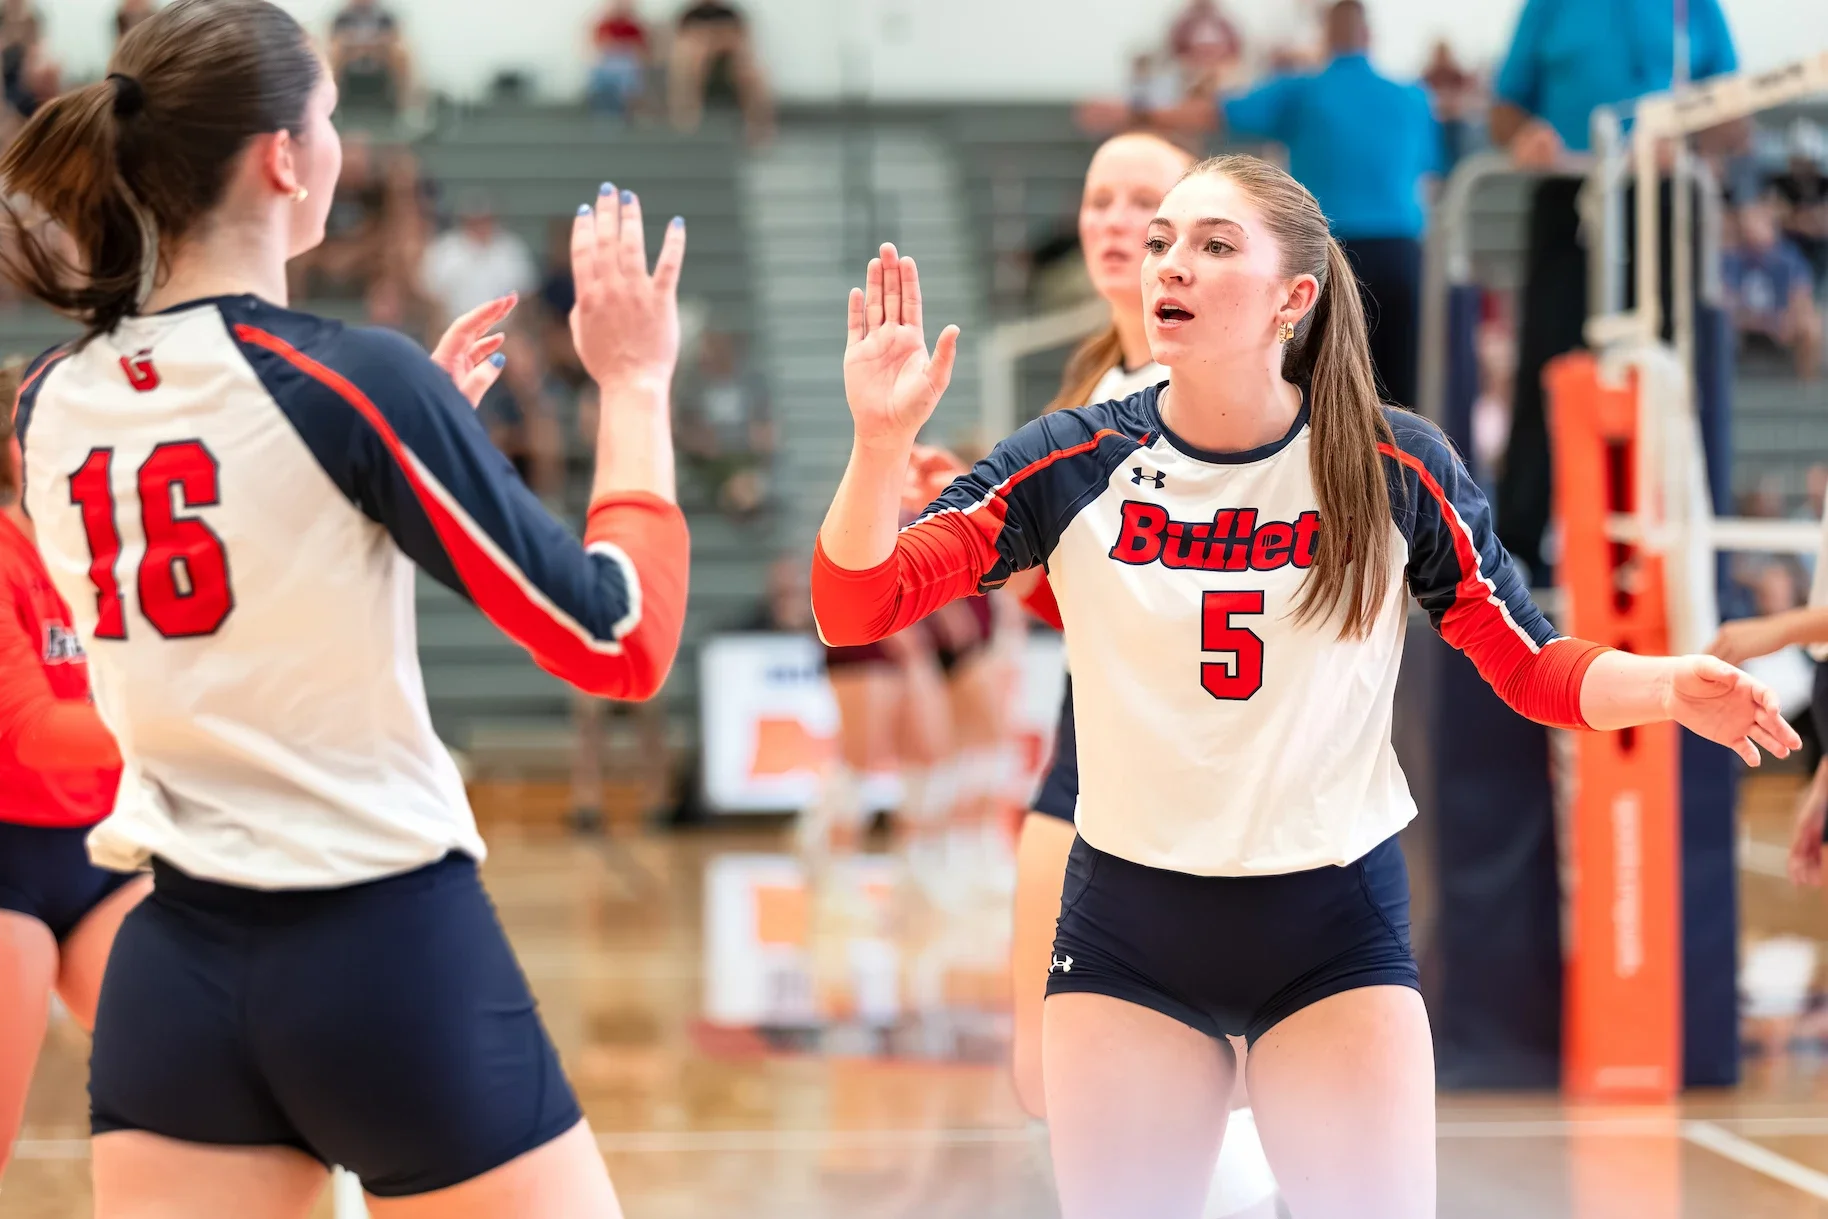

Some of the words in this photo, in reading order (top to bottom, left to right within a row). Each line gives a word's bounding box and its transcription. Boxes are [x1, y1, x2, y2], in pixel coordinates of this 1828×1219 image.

[68, 438, 235, 641] 16
[1108, 499, 1353, 571] Bullet
[1200, 589, 1264, 701] 5
